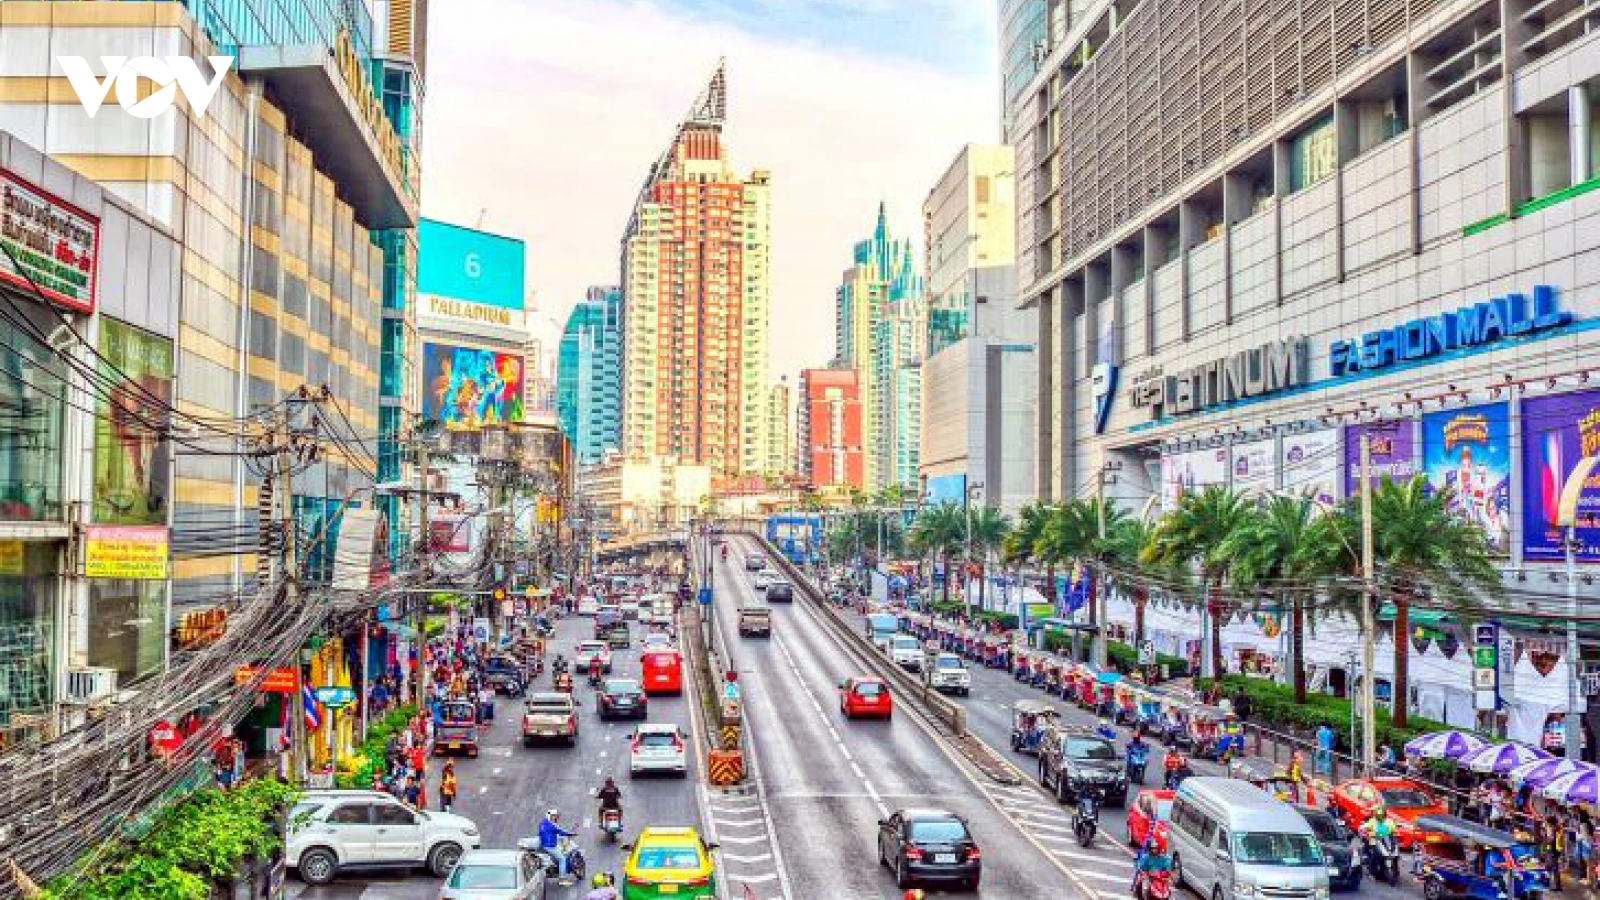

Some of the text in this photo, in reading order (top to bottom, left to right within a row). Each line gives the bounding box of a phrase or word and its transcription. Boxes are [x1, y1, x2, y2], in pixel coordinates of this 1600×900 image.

[464, 252, 481, 278] 6
[430, 297, 510, 325] PALLADIUM
[1150, 337, 1309, 421] PLATINUM
[1329, 312, 1458, 376] FASHION
[1457, 285, 1574, 347] MALL
